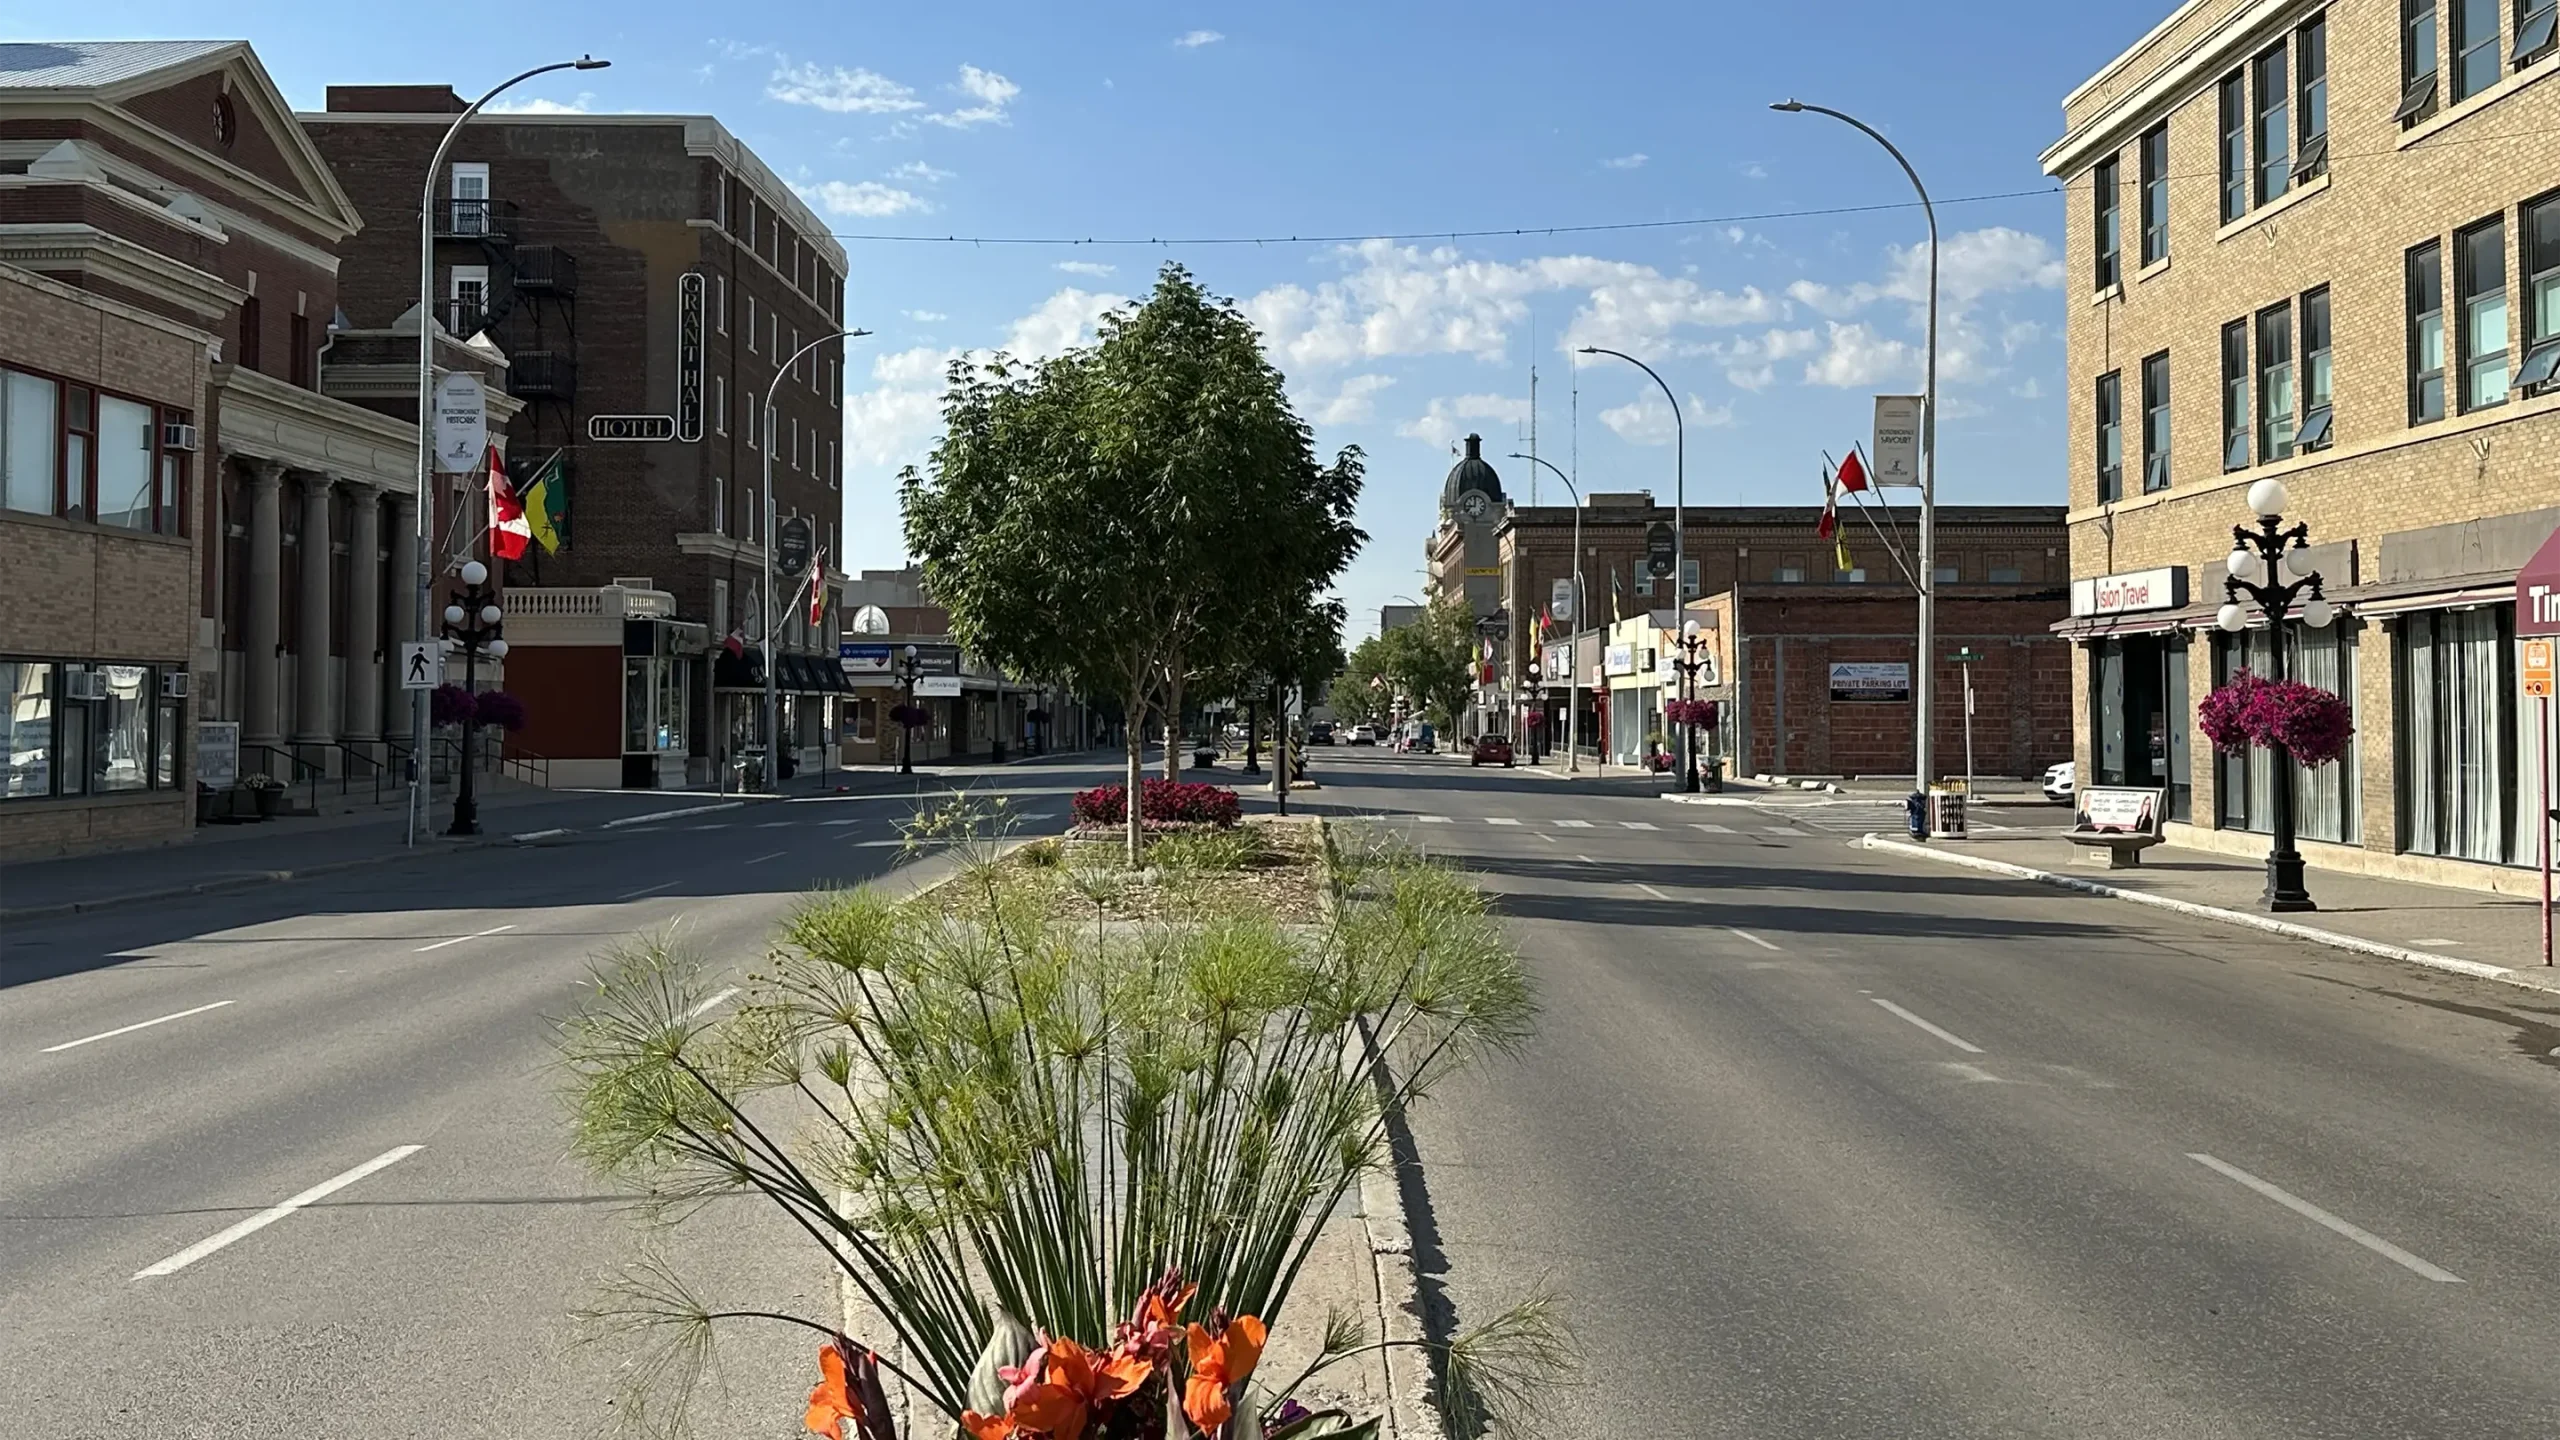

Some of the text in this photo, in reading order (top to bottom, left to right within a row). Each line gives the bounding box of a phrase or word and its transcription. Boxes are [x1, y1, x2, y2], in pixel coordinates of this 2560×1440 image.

[682, 276, 700, 439] GRANT HALL
[595, 420, 669, 437] HOTEL
[2121, 580, 2149, 606] Travel
[1832, 680, 1907, 688] PRIVATE PARKING LOT
